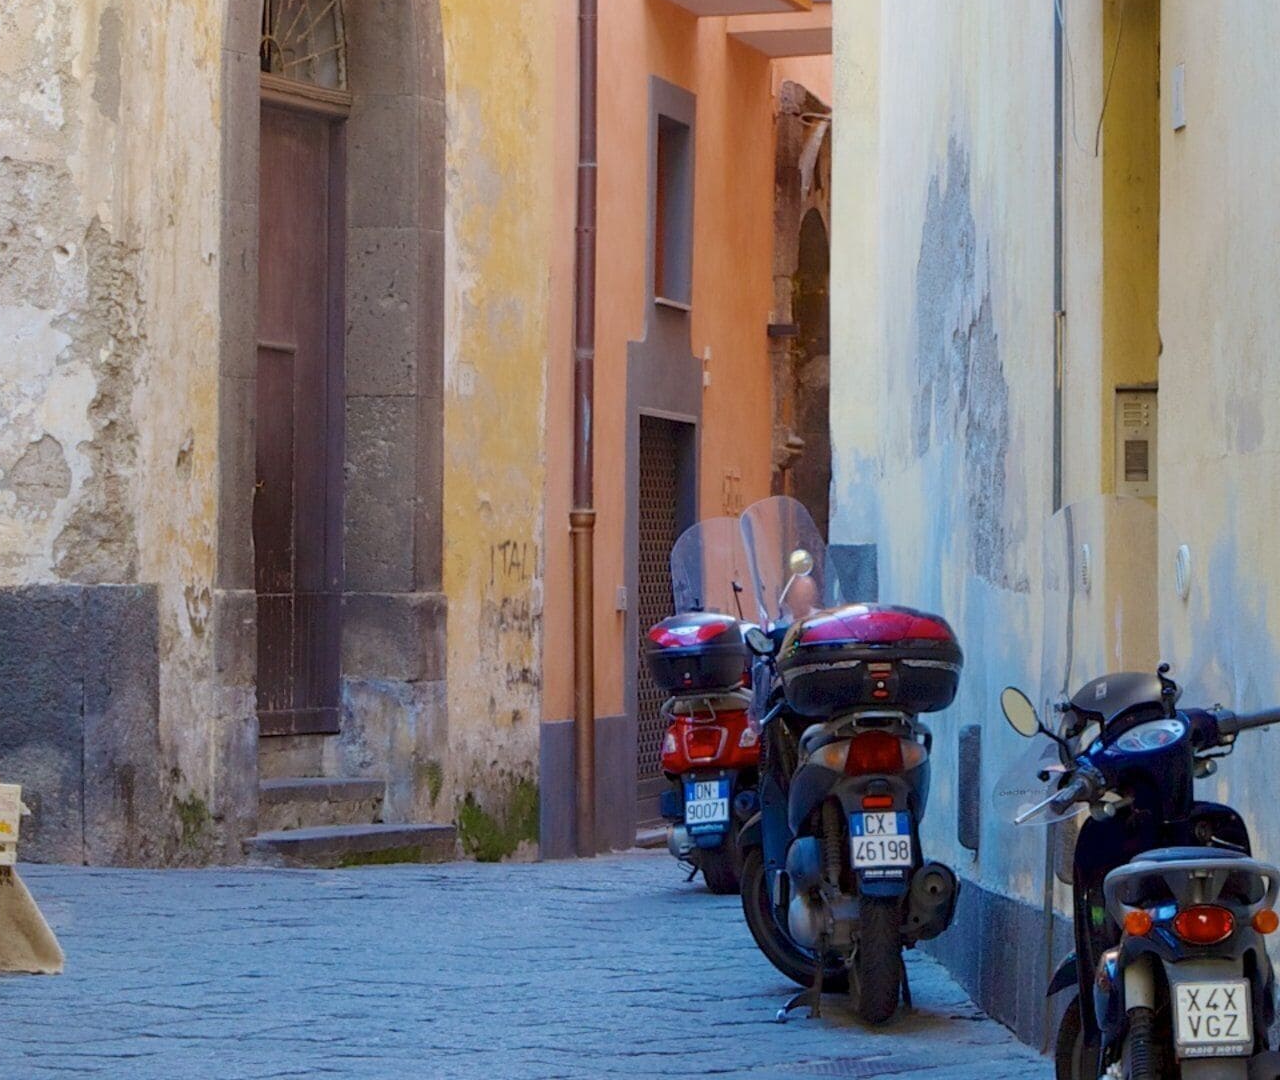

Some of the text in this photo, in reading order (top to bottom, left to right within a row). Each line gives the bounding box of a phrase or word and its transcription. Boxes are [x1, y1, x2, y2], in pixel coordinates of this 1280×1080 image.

[687, 802, 725, 820] 90071
[864, 814, 886, 834] CX
[855, 840, 909, 862] 46198
[1186, 988, 1237, 1012] X4X
[1187, 1014, 1240, 1038] VGZ
